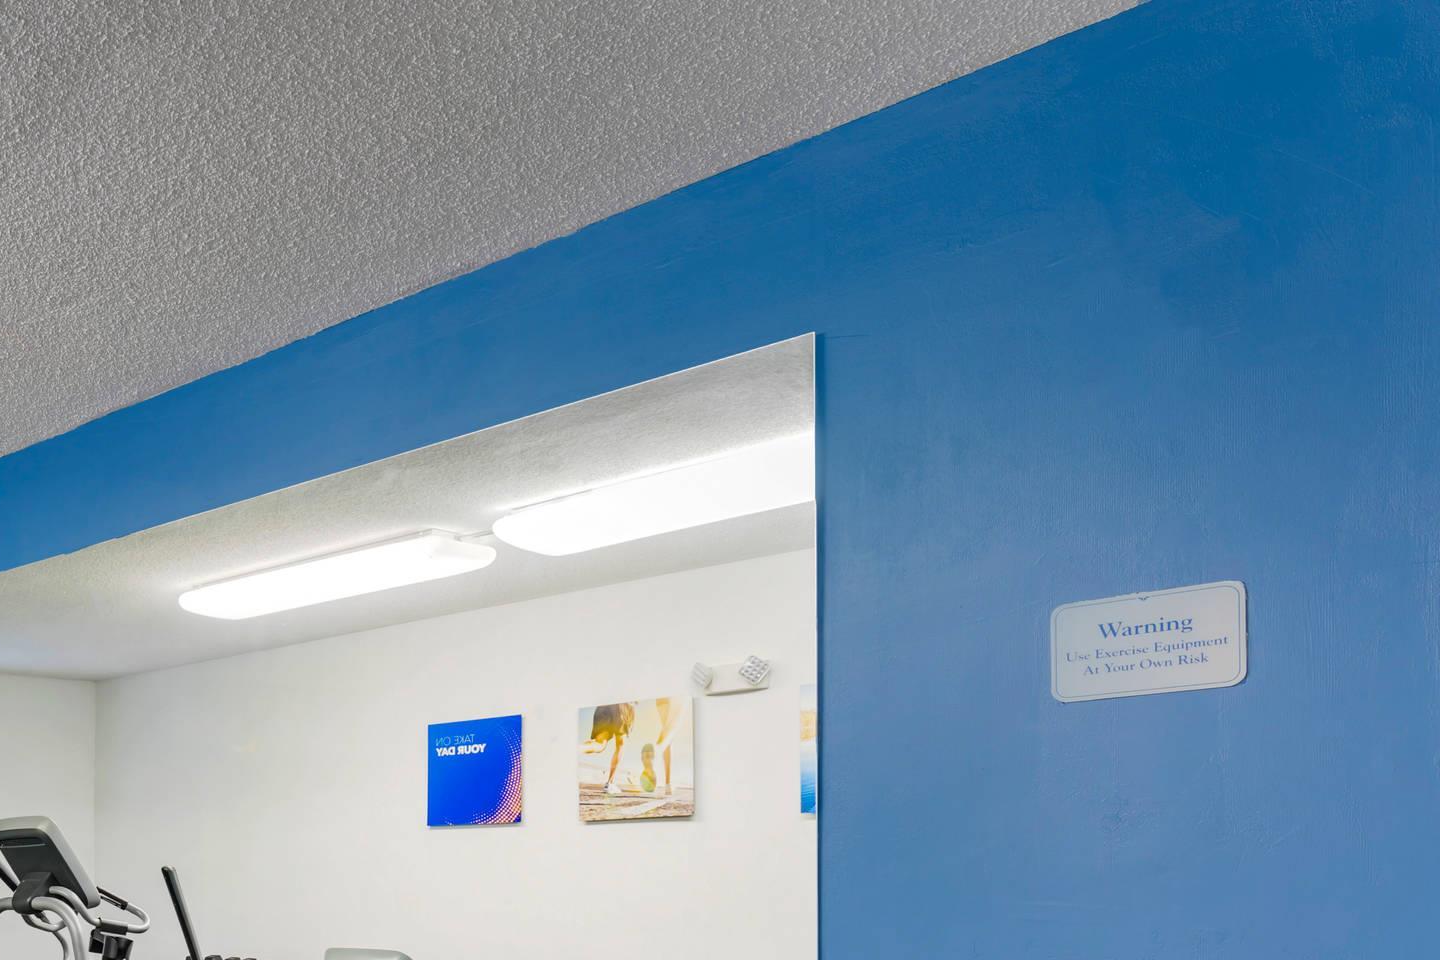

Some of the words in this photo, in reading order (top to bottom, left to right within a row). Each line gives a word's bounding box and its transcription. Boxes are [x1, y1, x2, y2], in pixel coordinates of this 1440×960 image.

[1097, 616, 1193, 639] Warning
[1066, 652, 1091, 662] Use
[1095, 645, 1149, 659] Exercise
[1154, 636, 1229, 654] Equipment
[1083, 665, 1100, 676] At
[1104, 662, 1136, 673] Your
[1139, 658, 1173, 669] Own
[1178, 652, 1209, 666] Risk
